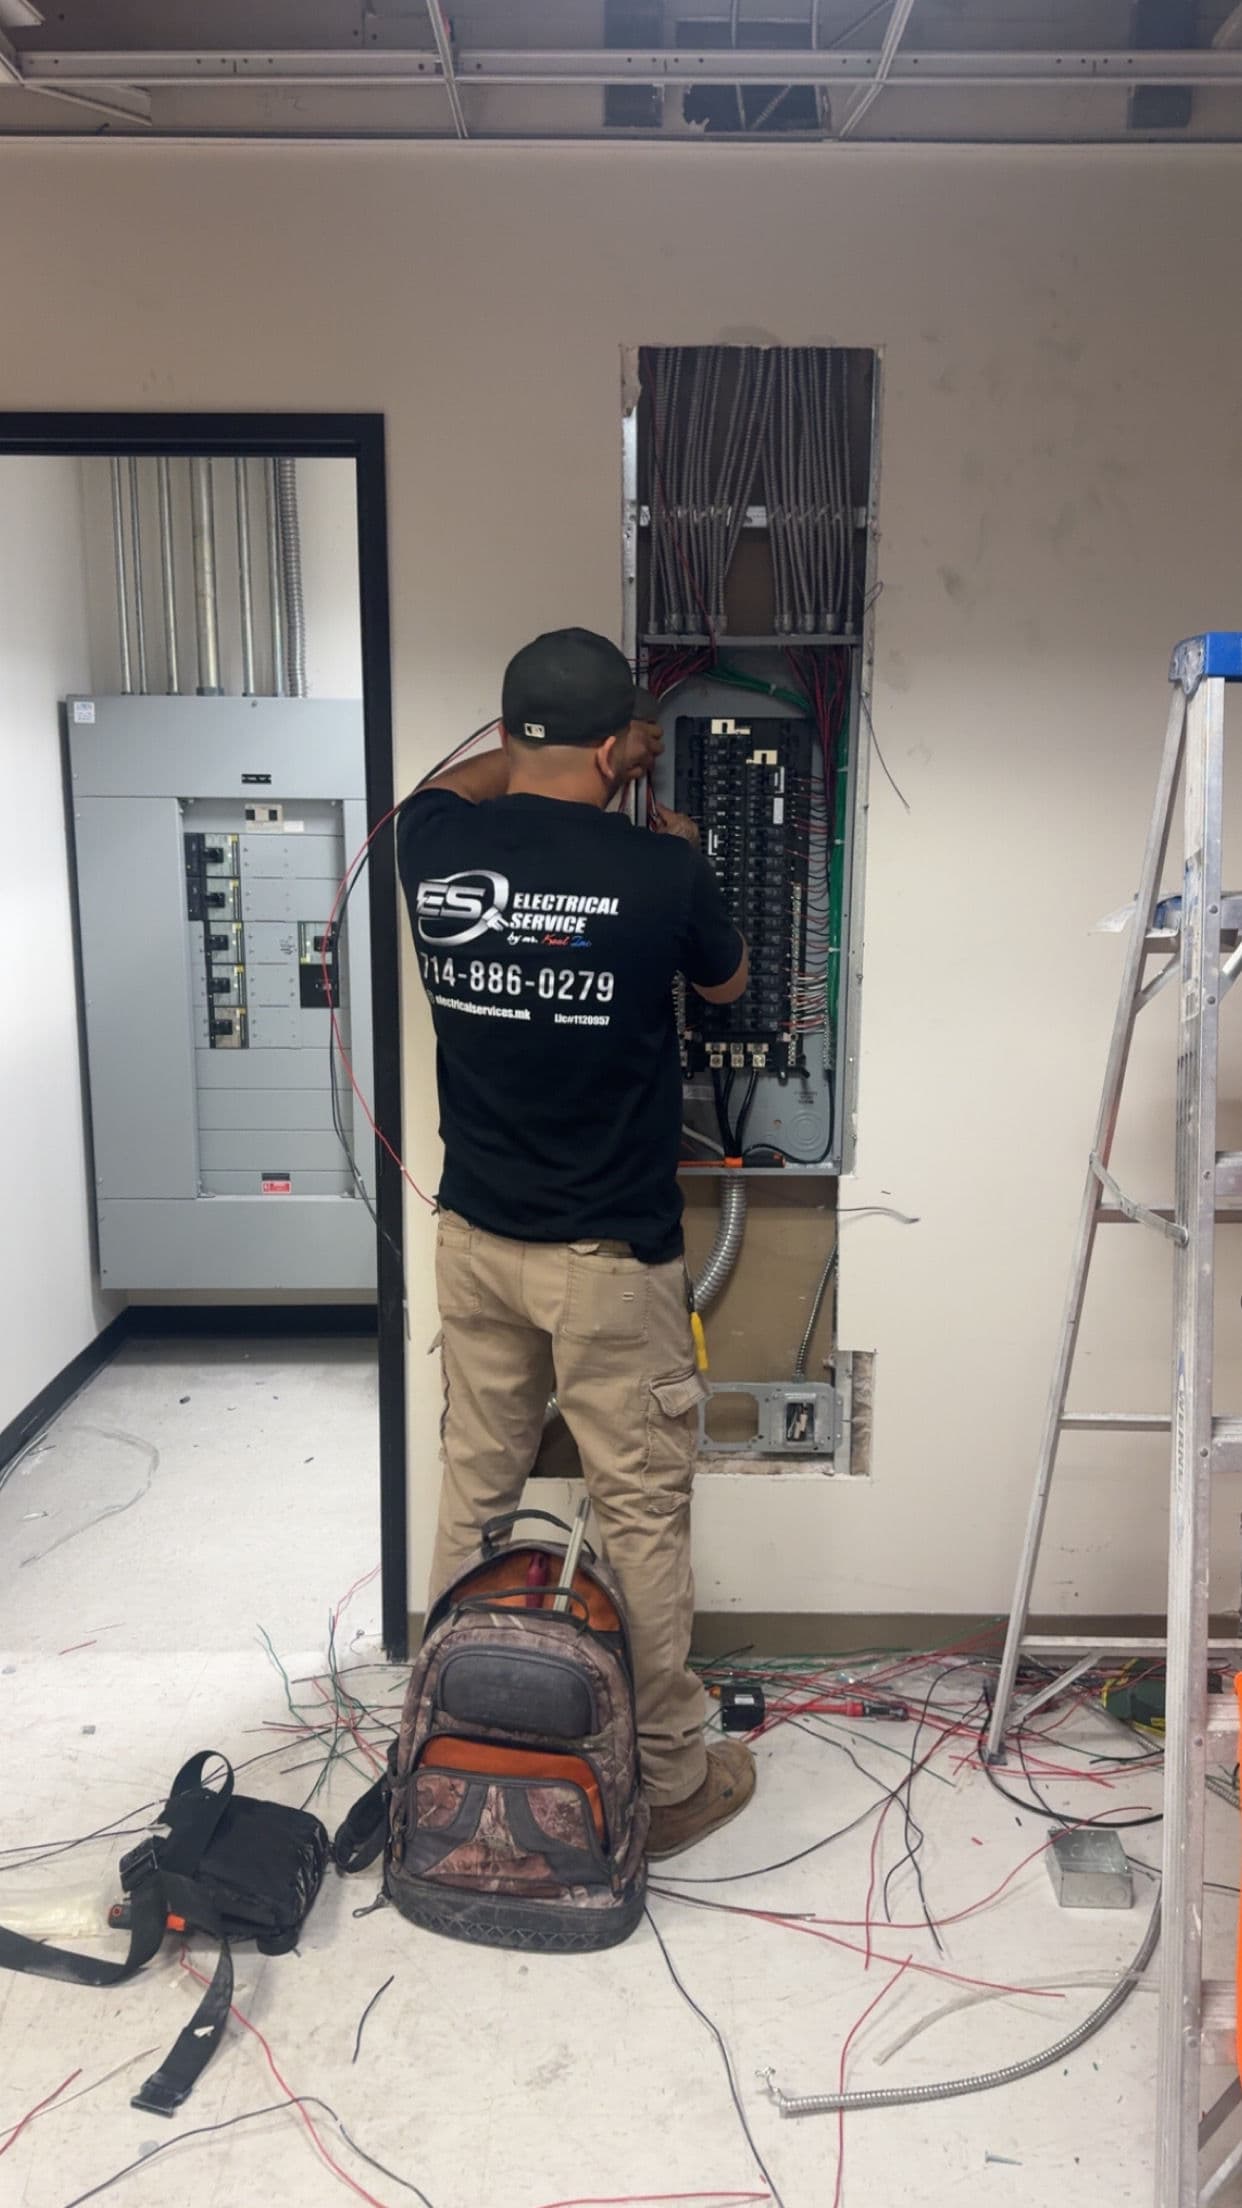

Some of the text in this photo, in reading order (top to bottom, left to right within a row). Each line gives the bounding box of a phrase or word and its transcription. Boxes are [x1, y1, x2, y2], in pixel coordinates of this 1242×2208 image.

[513, 892, 620, 916] ELECTRICAL
[510, 912, 588, 934] SERVICE
[420, 951, 615, 1003] 714-886-0279
